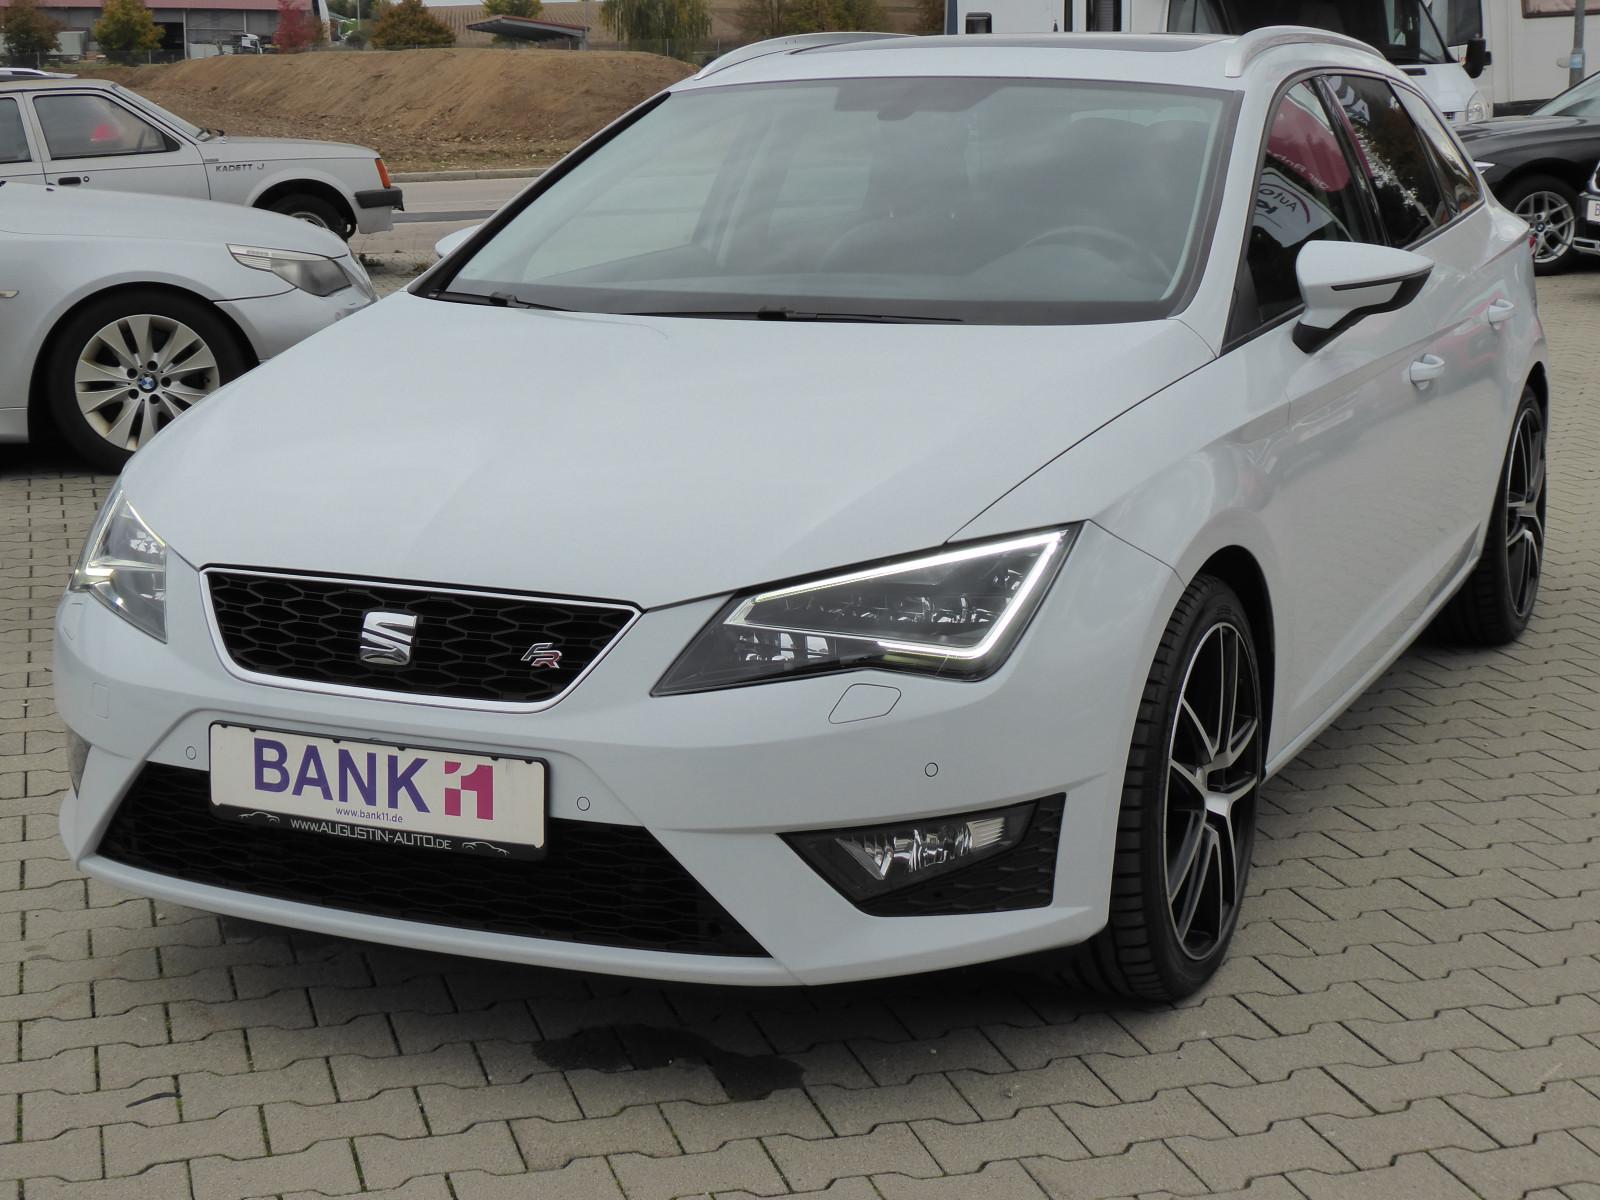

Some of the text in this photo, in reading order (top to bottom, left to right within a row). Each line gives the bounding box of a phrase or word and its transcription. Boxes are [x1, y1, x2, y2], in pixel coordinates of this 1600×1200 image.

[215, 163, 253, 172] KADETT
[520, 642, 563, 669] FR
[253, 737, 431, 814] BANK
[335, 807, 404, 824] www.bank11.de
